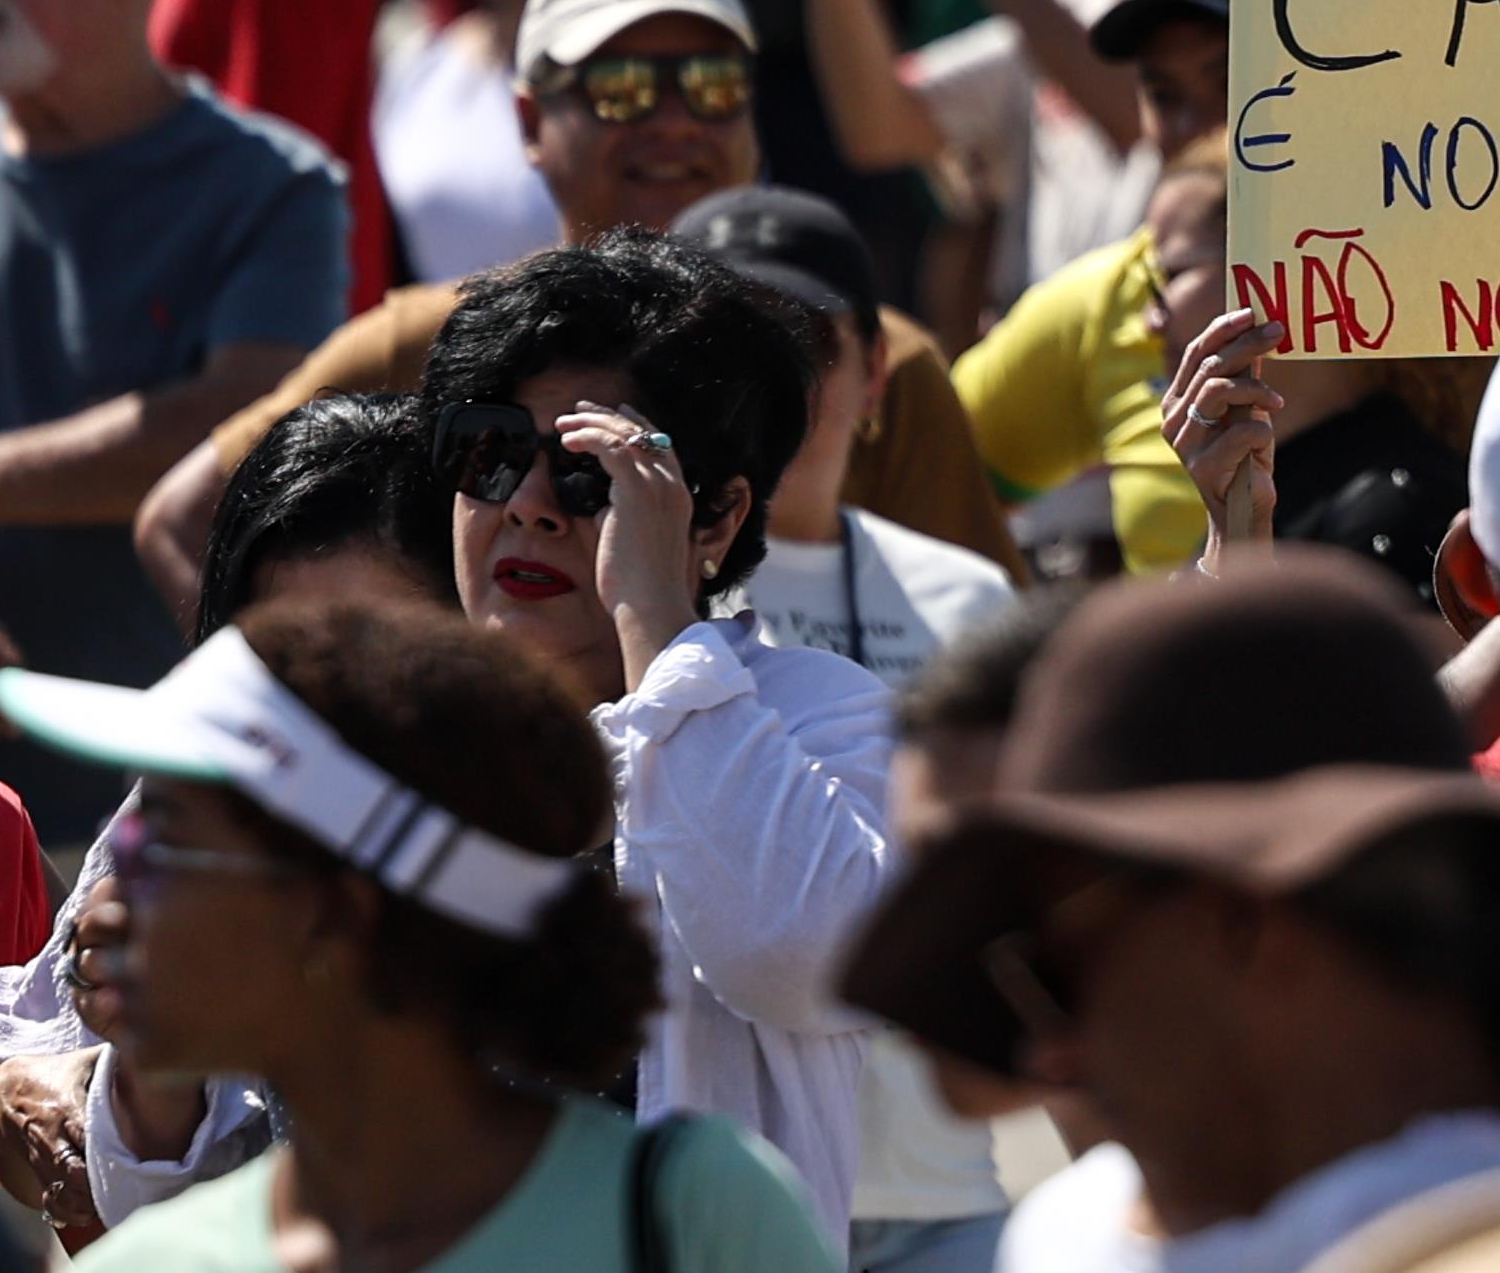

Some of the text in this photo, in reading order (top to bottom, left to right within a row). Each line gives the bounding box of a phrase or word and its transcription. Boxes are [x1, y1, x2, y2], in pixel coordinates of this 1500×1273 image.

[1234, 71, 1296, 172] É
[1382, 117, 1499, 210] NO
[1231, 228, 1394, 354] NÃO
